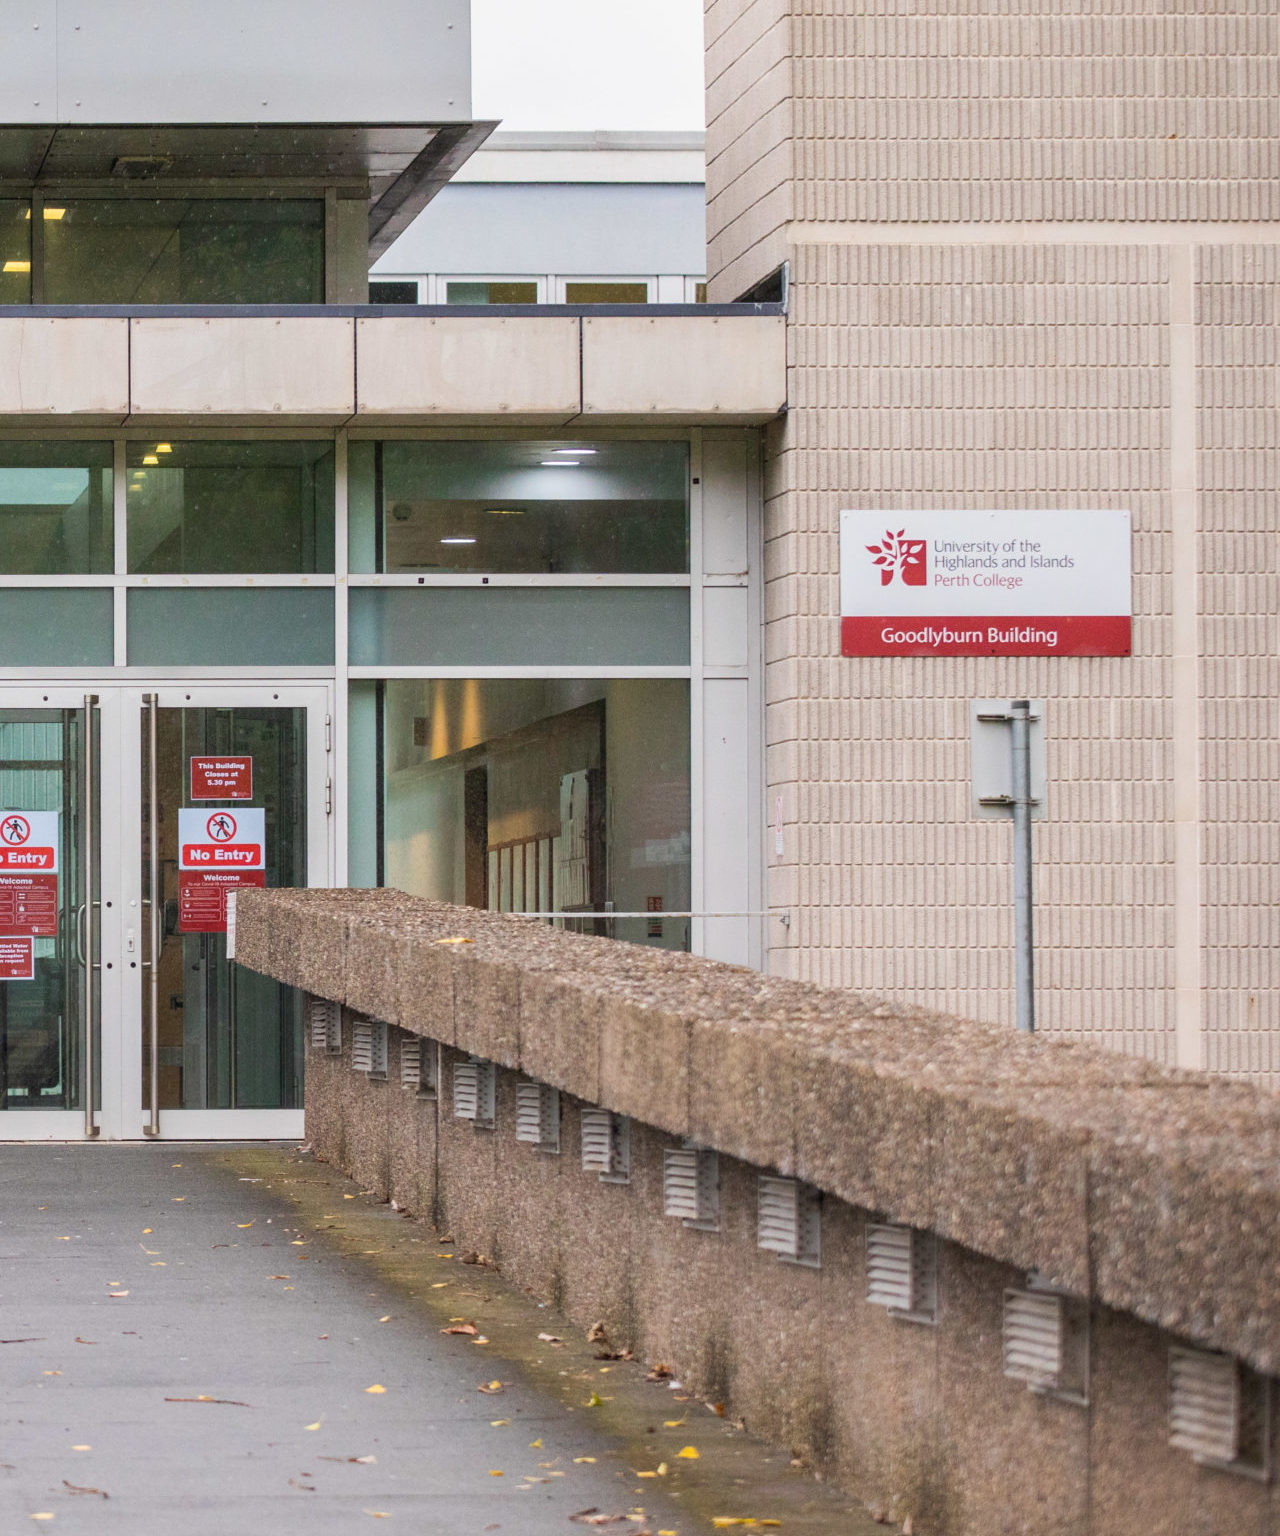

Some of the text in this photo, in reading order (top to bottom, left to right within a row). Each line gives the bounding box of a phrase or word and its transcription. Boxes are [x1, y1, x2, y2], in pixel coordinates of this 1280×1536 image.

[934, 539, 1041, 555] University of the
[934, 555, 1074, 571] Highlands and Islands
[934, 573, 1023, 589] Perth College
[881, 626, 1058, 647] Goodlyburn Building
[215, 762, 245, 770] Building
[7, 852, 47, 866] Entry
[190, 849, 254, 863] No Entry
